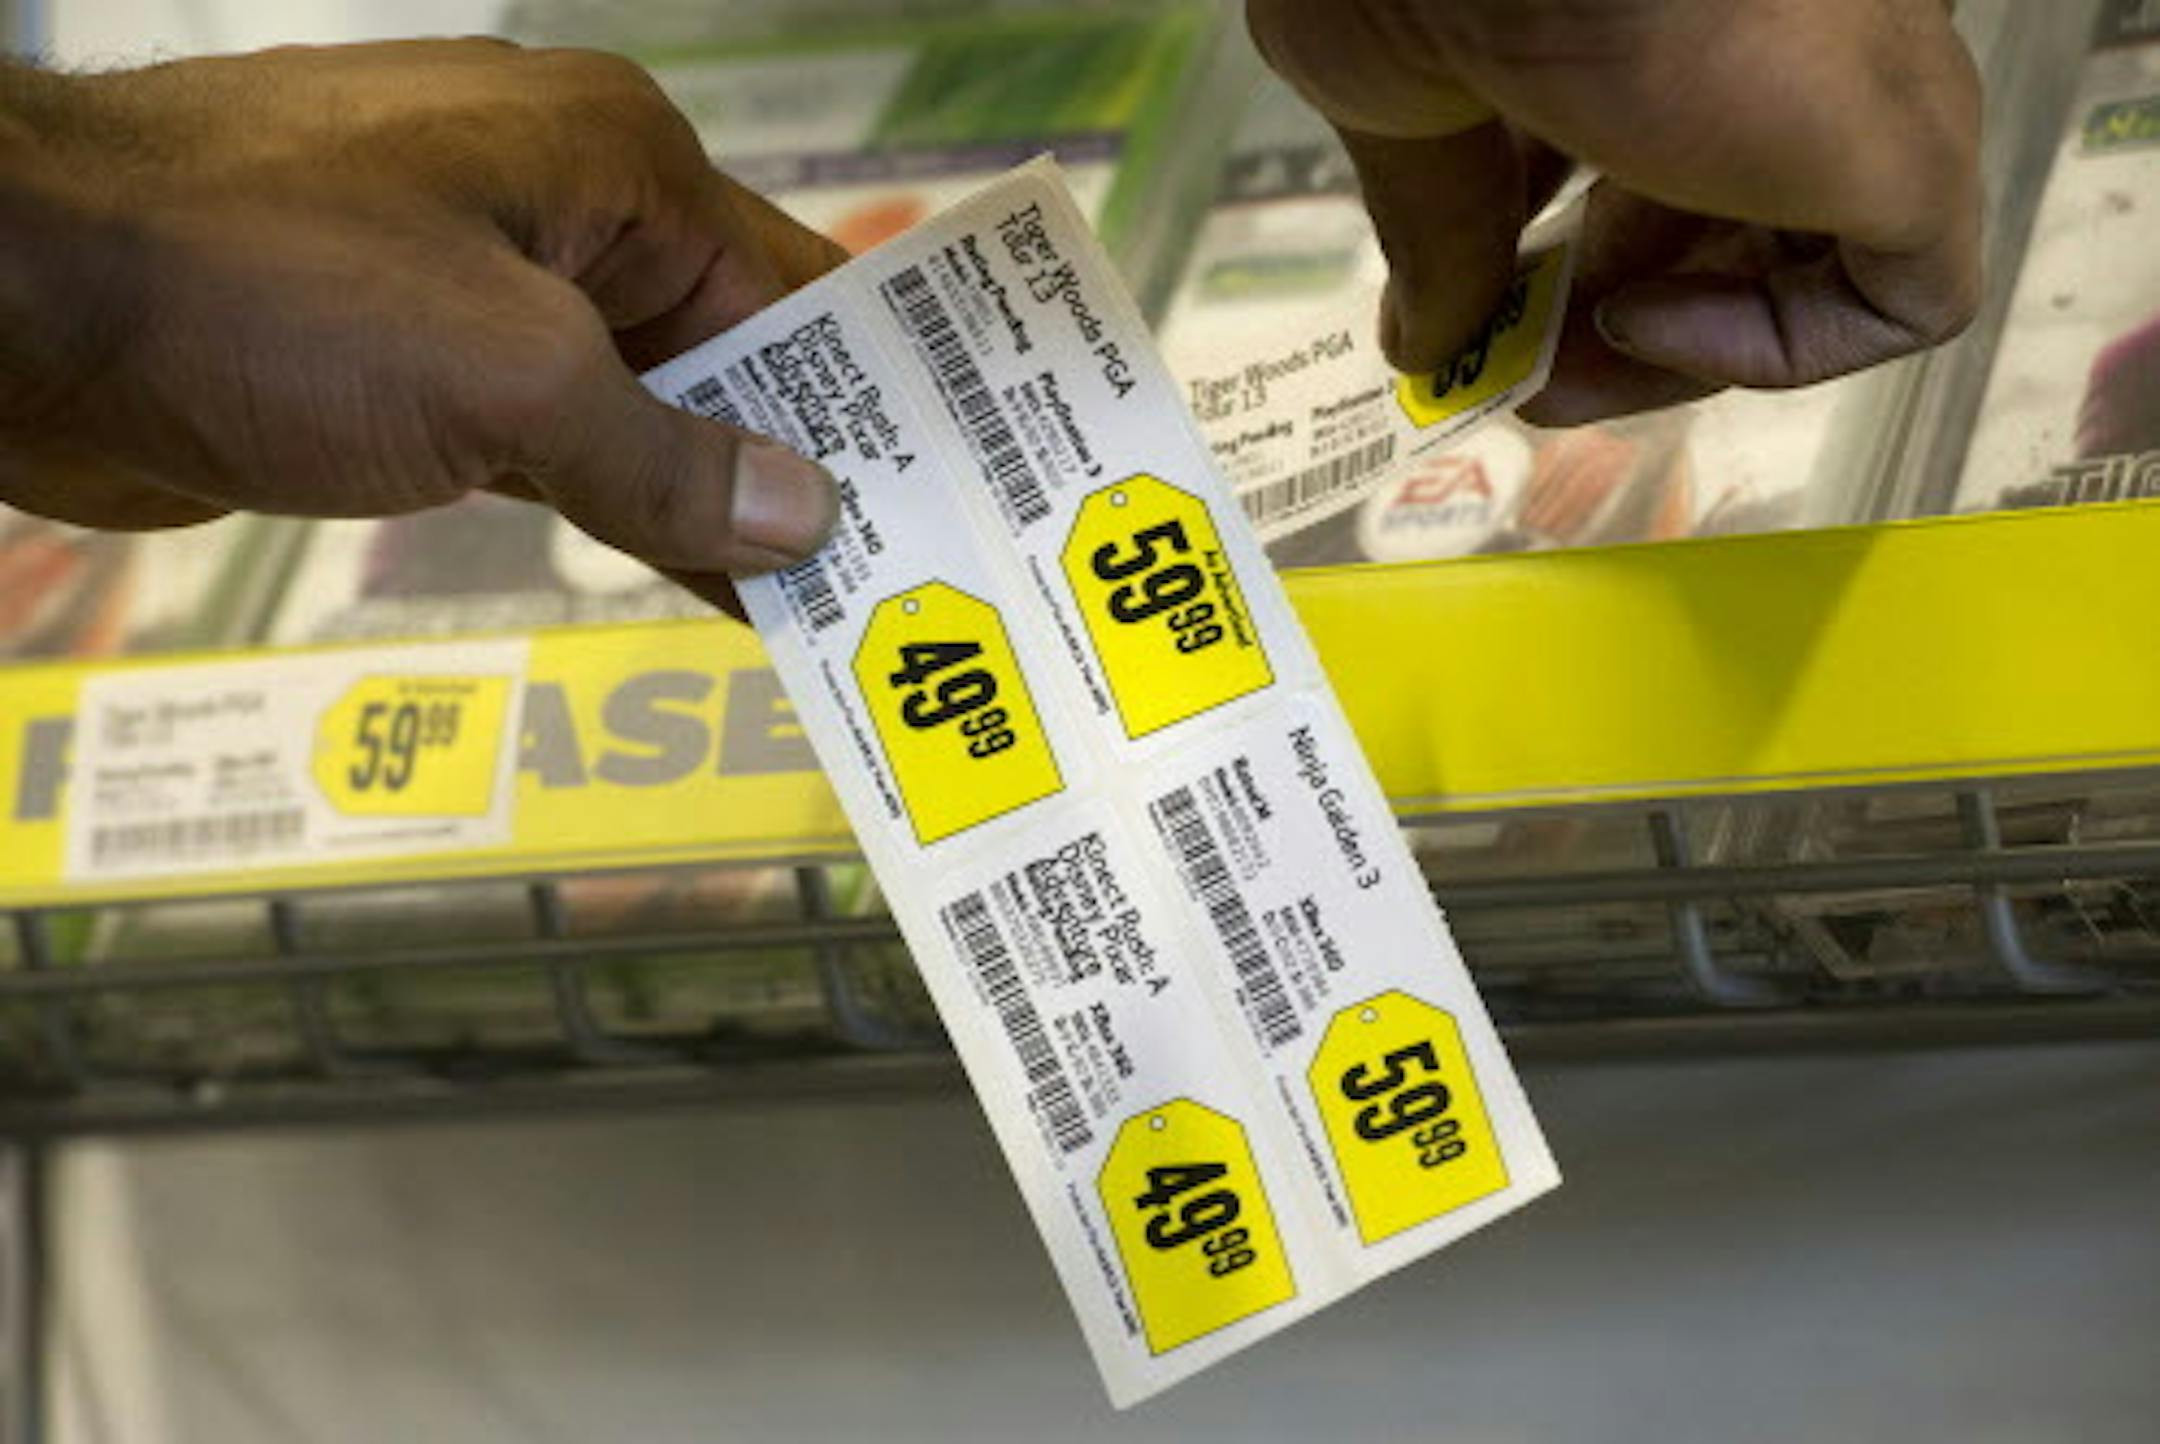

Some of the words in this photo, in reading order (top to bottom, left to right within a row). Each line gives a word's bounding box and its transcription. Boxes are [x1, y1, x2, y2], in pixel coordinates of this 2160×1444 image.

[988, 285, 1031, 355] Pending
[995, 212, 1032, 265] Tour
[1024, 269, 1058, 304] 13
[1010, 202, 1058, 261] Tiger
[1049, 262, 1101, 343] Woods
[1092, 342, 1135, 399] PGA
[788, 323, 845, 408] Disney
[838, 401, 880, 460] Pixar
[811, 312, 865, 386] Kinect
[854, 384, 898, 451] Rush:
[892, 454, 915, 473] A
[1312, 330, 1354, 365] PGA
[1036, 371, 1091, 463] PlayStation
[1087, 464, 1101, 478] 3
[857, 520, 882, 555] 360
[1287, 725, 1327, 790] Ninja
[1356, 868, 1380, 890] 3
[1049, 841, 1105, 924] Disney
[1095, 924, 1144, 985] Pixar
[1074, 832, 1126, 910] Kinect
[1112, 908, 1155, 976] Rush:
[1145, 977, 1168, 996] A
